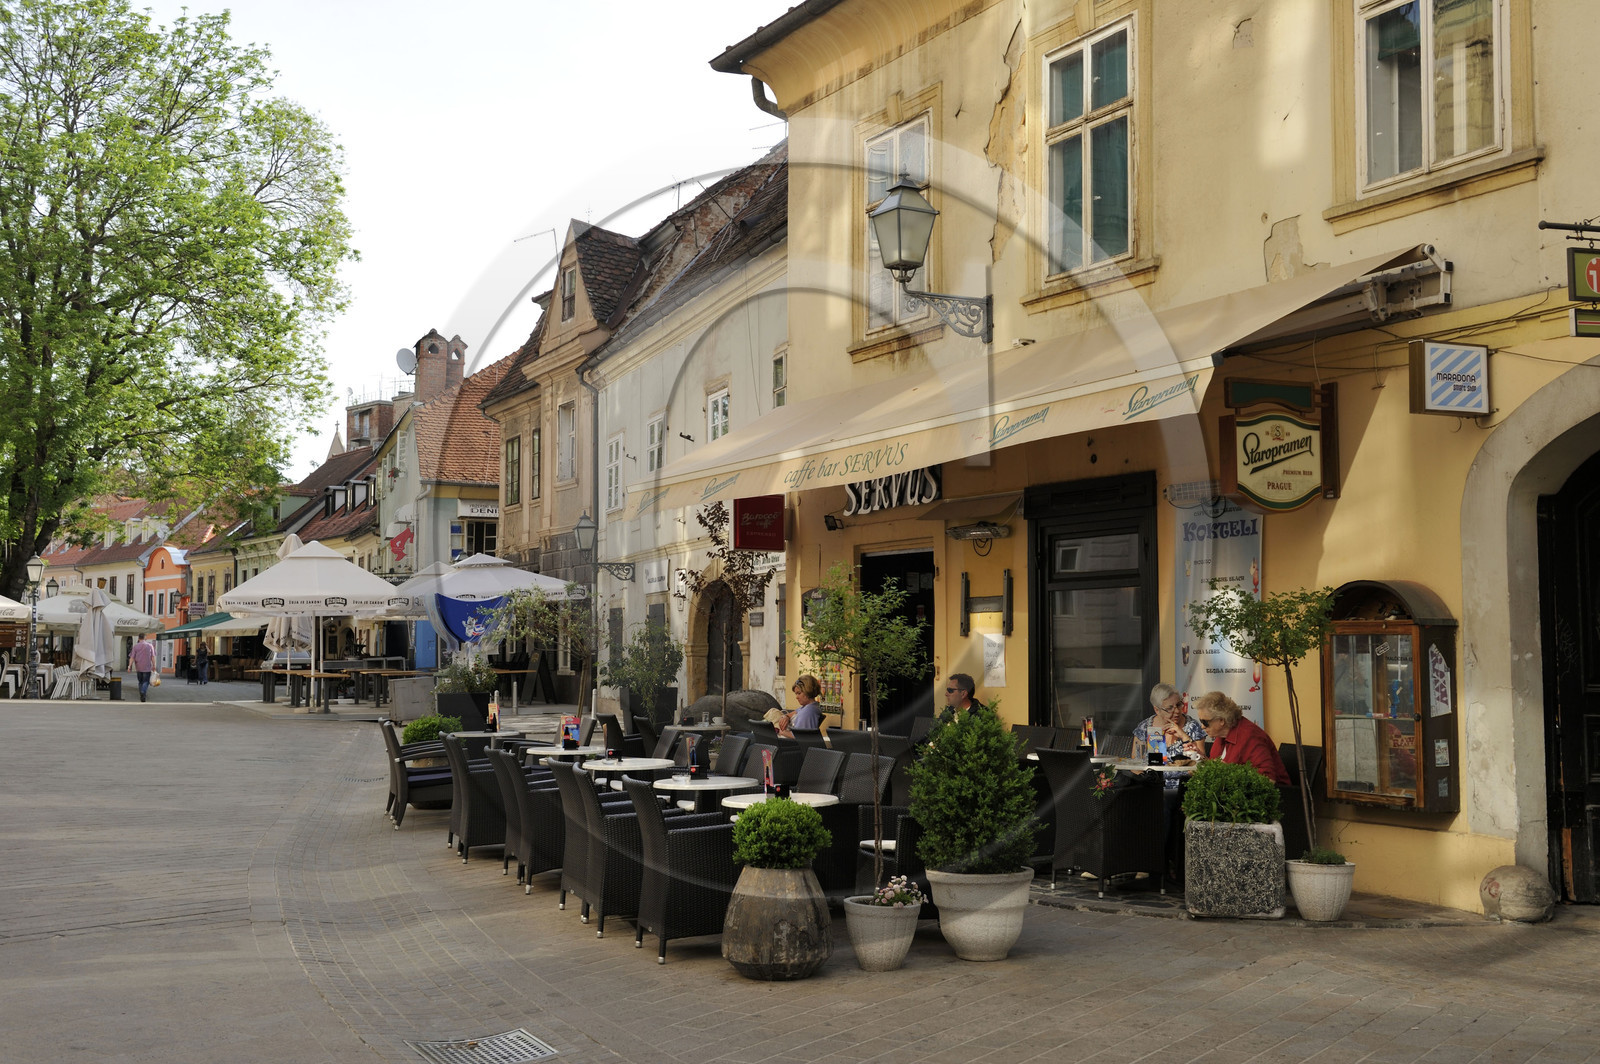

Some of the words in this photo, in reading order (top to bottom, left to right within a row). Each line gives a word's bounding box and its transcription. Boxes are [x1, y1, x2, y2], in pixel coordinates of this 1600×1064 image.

[1122, 373, 1200, 421] Staropramen
[1436, 372, 1476, 383] MARADONA
[989, 406, 1050, 447] Staropramen
[783, 459, 816, 488] caffe
[816, 456, 841, 478] bar
[839, 441, 909, 477] SERVUS
[1242, 432, 1314, 474] Staropramen
[843, 466, 938, 517] SERVUS
[1267, 481, 1292, 491] PRAGUE
[1182, 518, 1259, 542] KOKTELI
